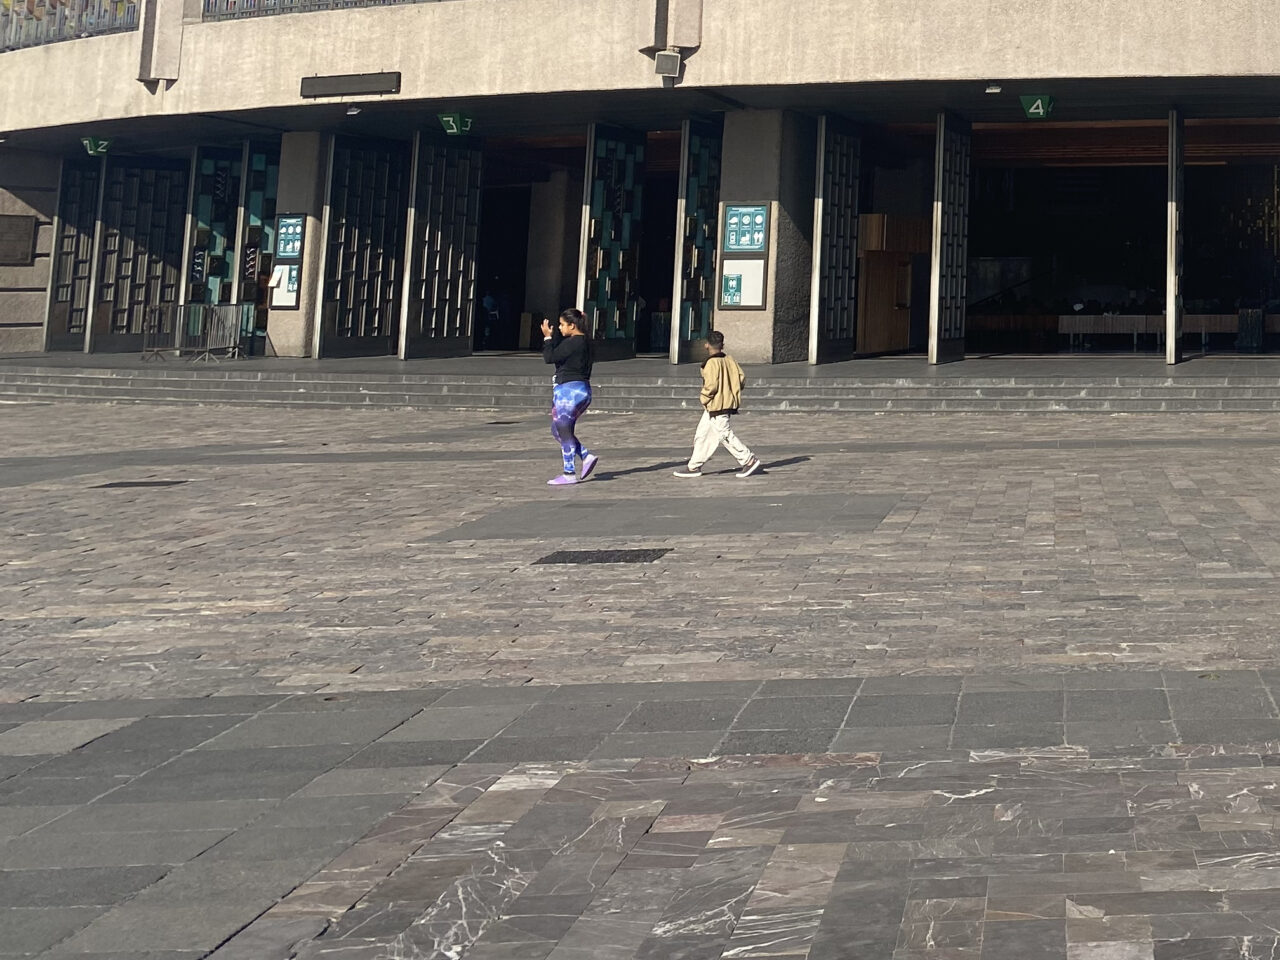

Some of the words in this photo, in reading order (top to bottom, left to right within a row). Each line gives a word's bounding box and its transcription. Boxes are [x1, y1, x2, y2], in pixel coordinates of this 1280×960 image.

[1029, 99, 1045, 116] 4
[442, 117, 458, 133] 3
[462, 118, 473, 131] 3
